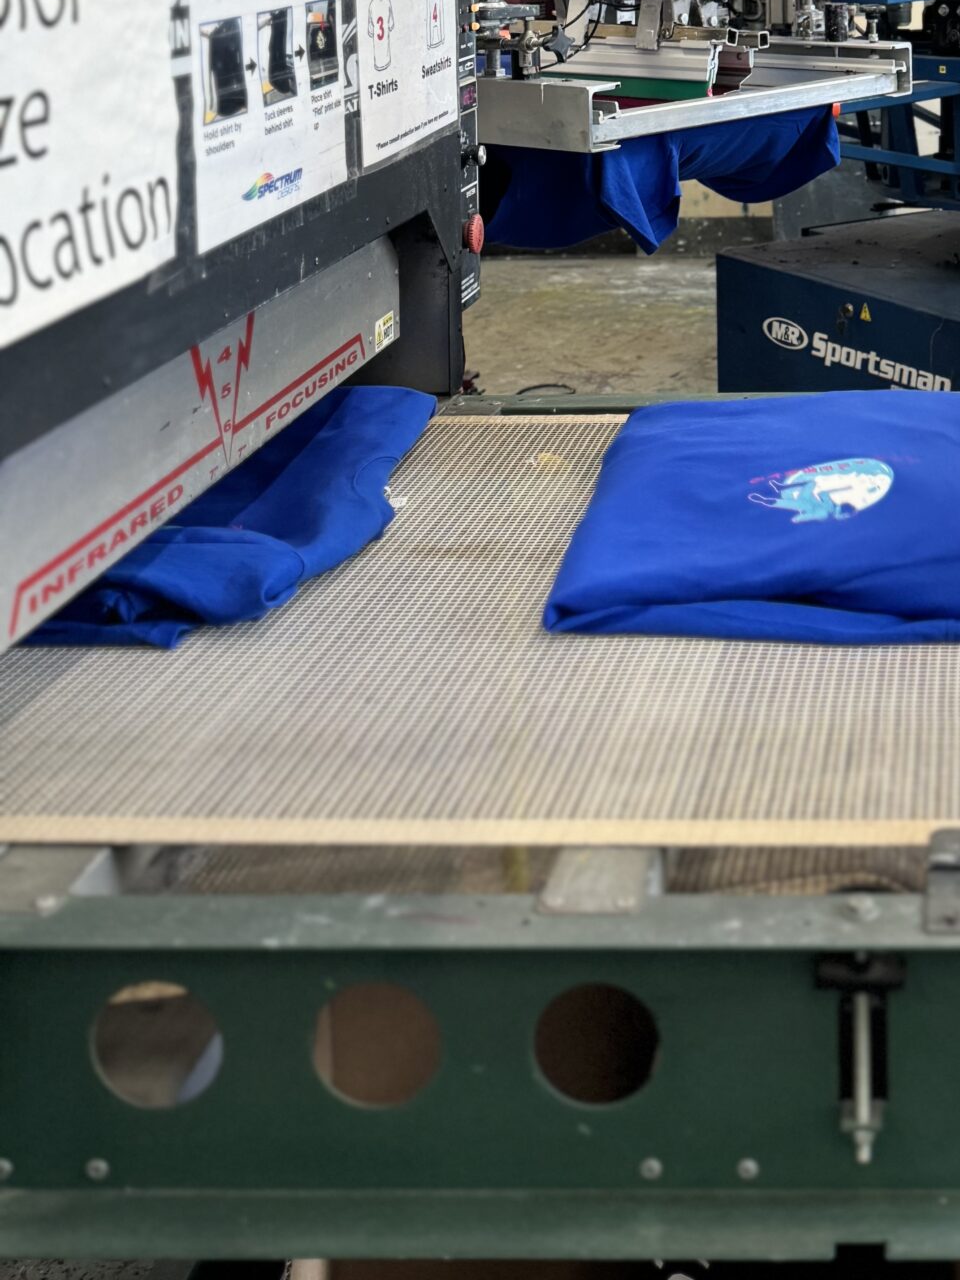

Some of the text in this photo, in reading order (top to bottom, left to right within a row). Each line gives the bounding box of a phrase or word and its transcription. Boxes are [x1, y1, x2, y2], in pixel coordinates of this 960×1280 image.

[432, 2, 438, 23] 4
[376, 16, 384, 41] 3
[421, 56, 452, 79] Sweatshirts
[368, 79, 398, 100] T-Shirts
[264, 110, 276, 121] Tuck
[203, 122, 242, 142] Hold shirt by
[264, 122, 282, 136] behind
[205, 140, 235, 156] shoulders
[257, 168, 303, 199] SPECTRUM
[771, 320, 800, 346] M&R
[217, 345, 233, 365] 4
[811, 332, 952, 392] Sportsman
[221, 382, 231, 400] 5
[265, 350, 358, 431] FOCUSING
[223, 419, 232, 433] 6
[29, 484, 184, 615] INFRARED
